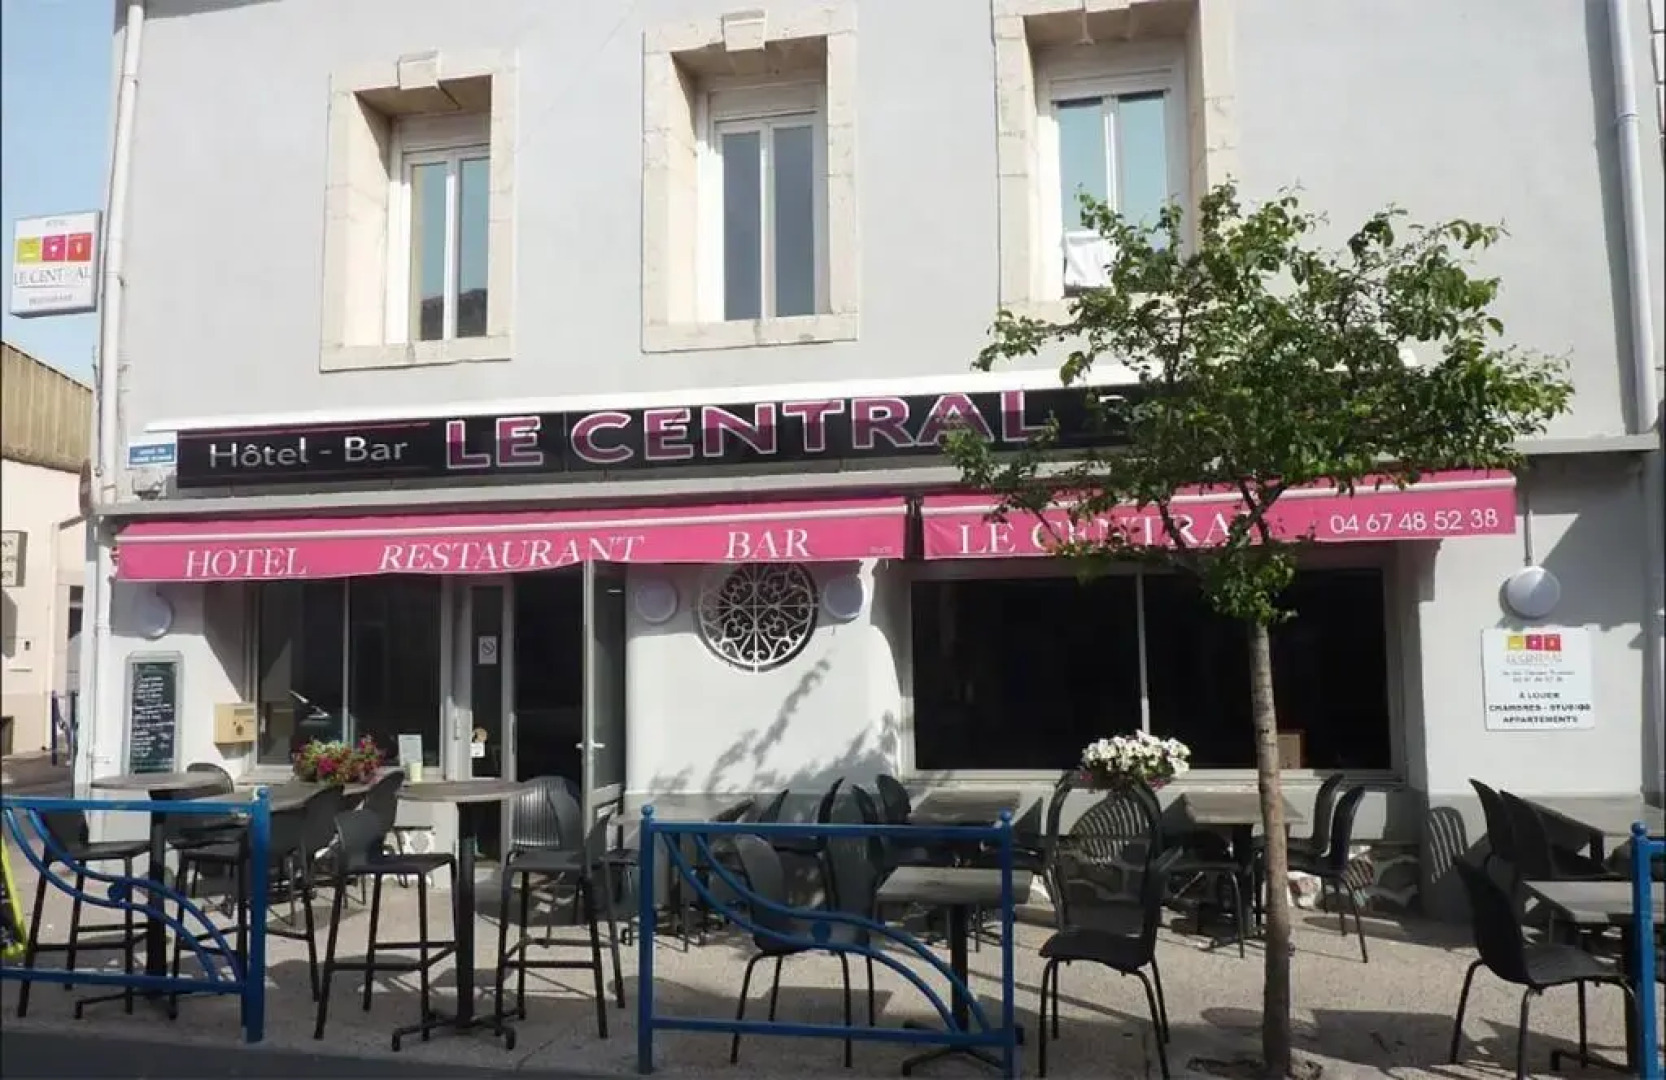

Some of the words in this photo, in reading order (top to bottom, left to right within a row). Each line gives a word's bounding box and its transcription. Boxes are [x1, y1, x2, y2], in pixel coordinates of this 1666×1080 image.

[209, 437, 309, 468] Hôtel
[344, 436, 407, 463] Bar
[446, 415, 543, 470] LE
[571, 389, 1047, 464] CENTRAL
[186, 546, 309, 578] HOTEL
[378, 534, 645, 571] RESTAURANT
[725, 528, 811, 560] BAR
[958, 521, 1016, 554] LE
[1330, 514, 1359, 534] 04
[1366, 513, 1394, 533] 67
[1399, 512, 1427, 532] 48
[1434, 510, 1463, 530] 52
[1470, 508, 1499, 528] 38
